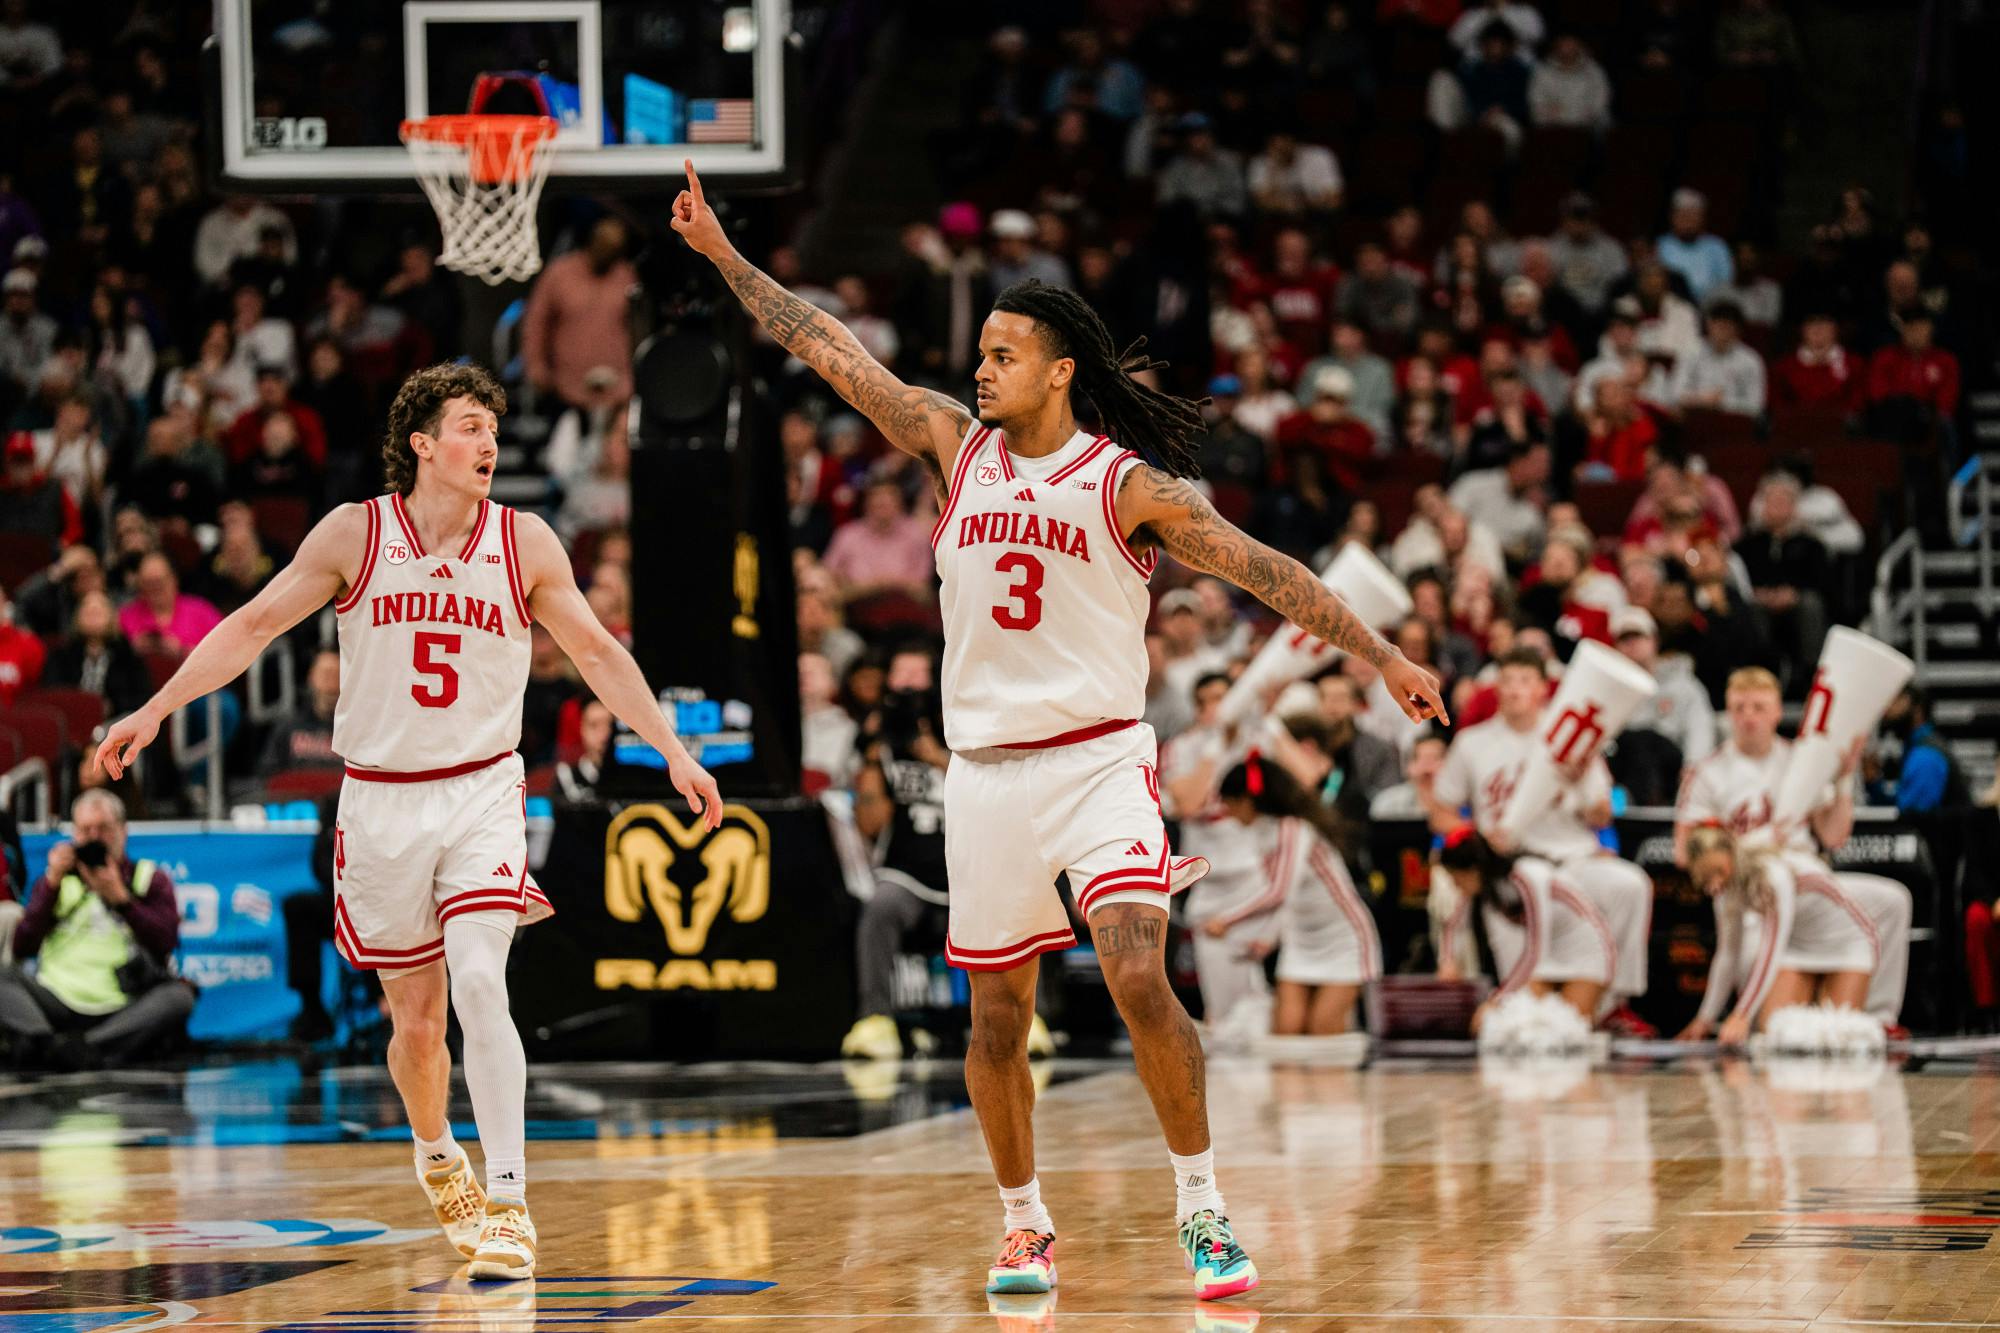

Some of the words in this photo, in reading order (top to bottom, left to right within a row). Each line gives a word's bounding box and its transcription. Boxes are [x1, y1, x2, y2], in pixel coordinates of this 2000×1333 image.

[957, 512, 1091, 563] INDIANA
[371, 591, 505, 638] INDIANA
[992, 551, 1045, 631] 3
[411, 631, 462, 709] 5
[595, 958, 777, 990] RAM
